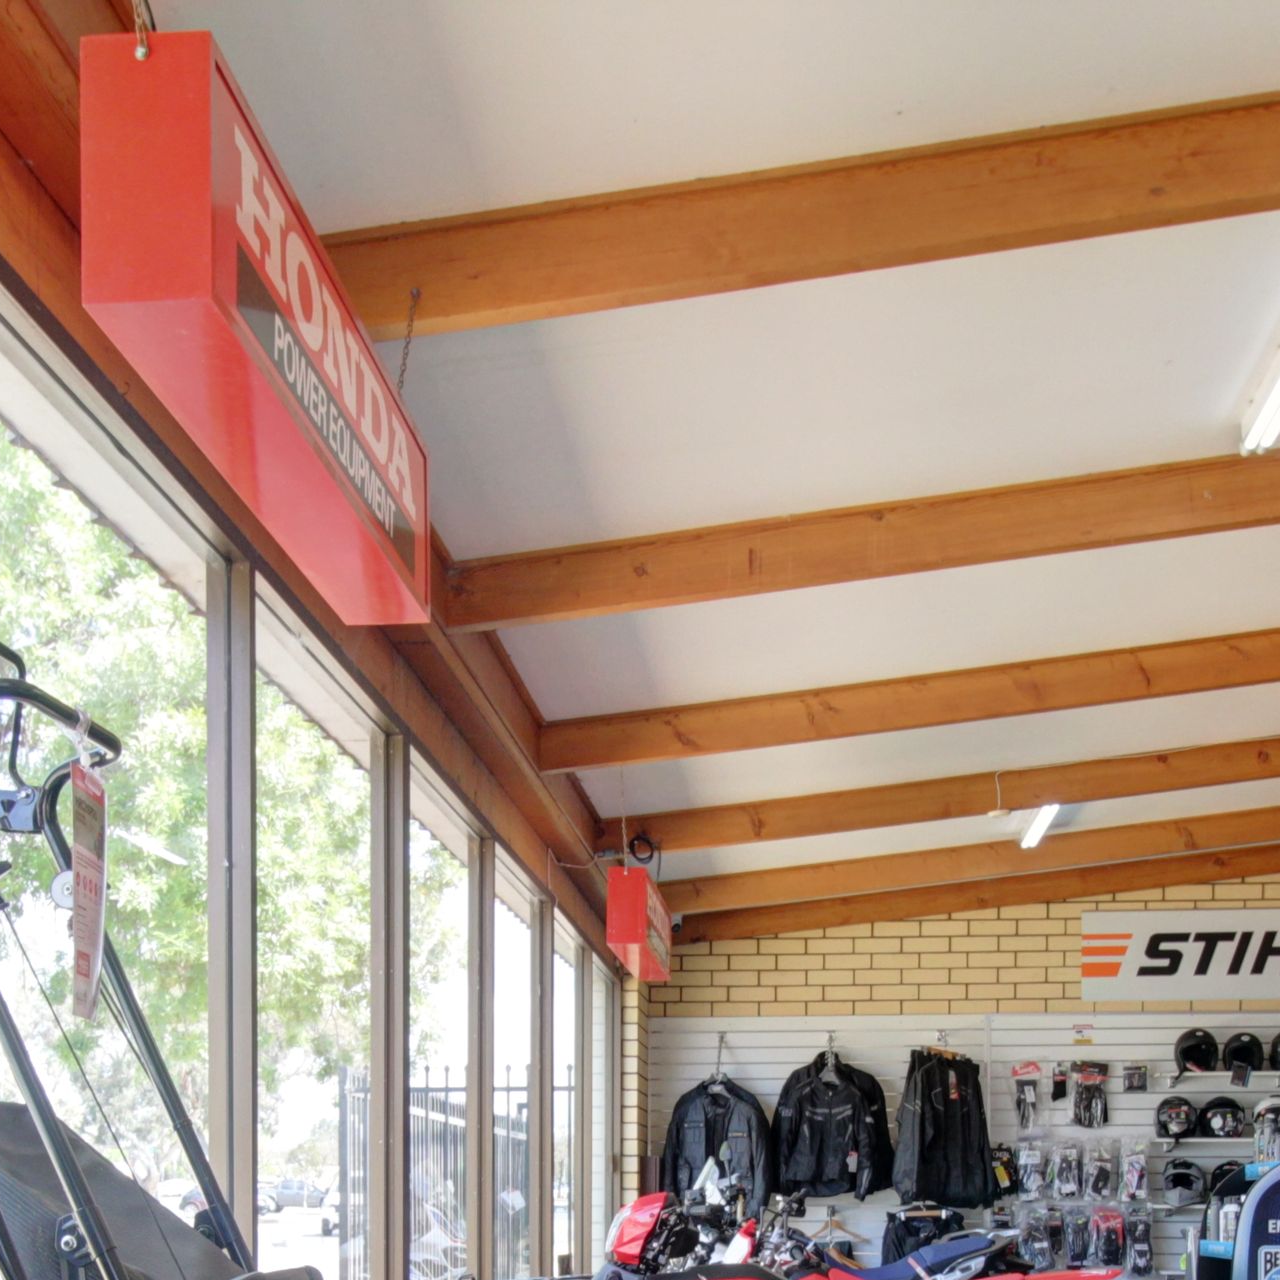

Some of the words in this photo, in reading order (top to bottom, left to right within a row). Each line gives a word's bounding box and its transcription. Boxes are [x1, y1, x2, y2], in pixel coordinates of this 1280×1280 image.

[234, 123, 416, 519] HONDA
[273, 312, 327, 428] POWER
[327, 408, 397, 538] EQUIPMENT
